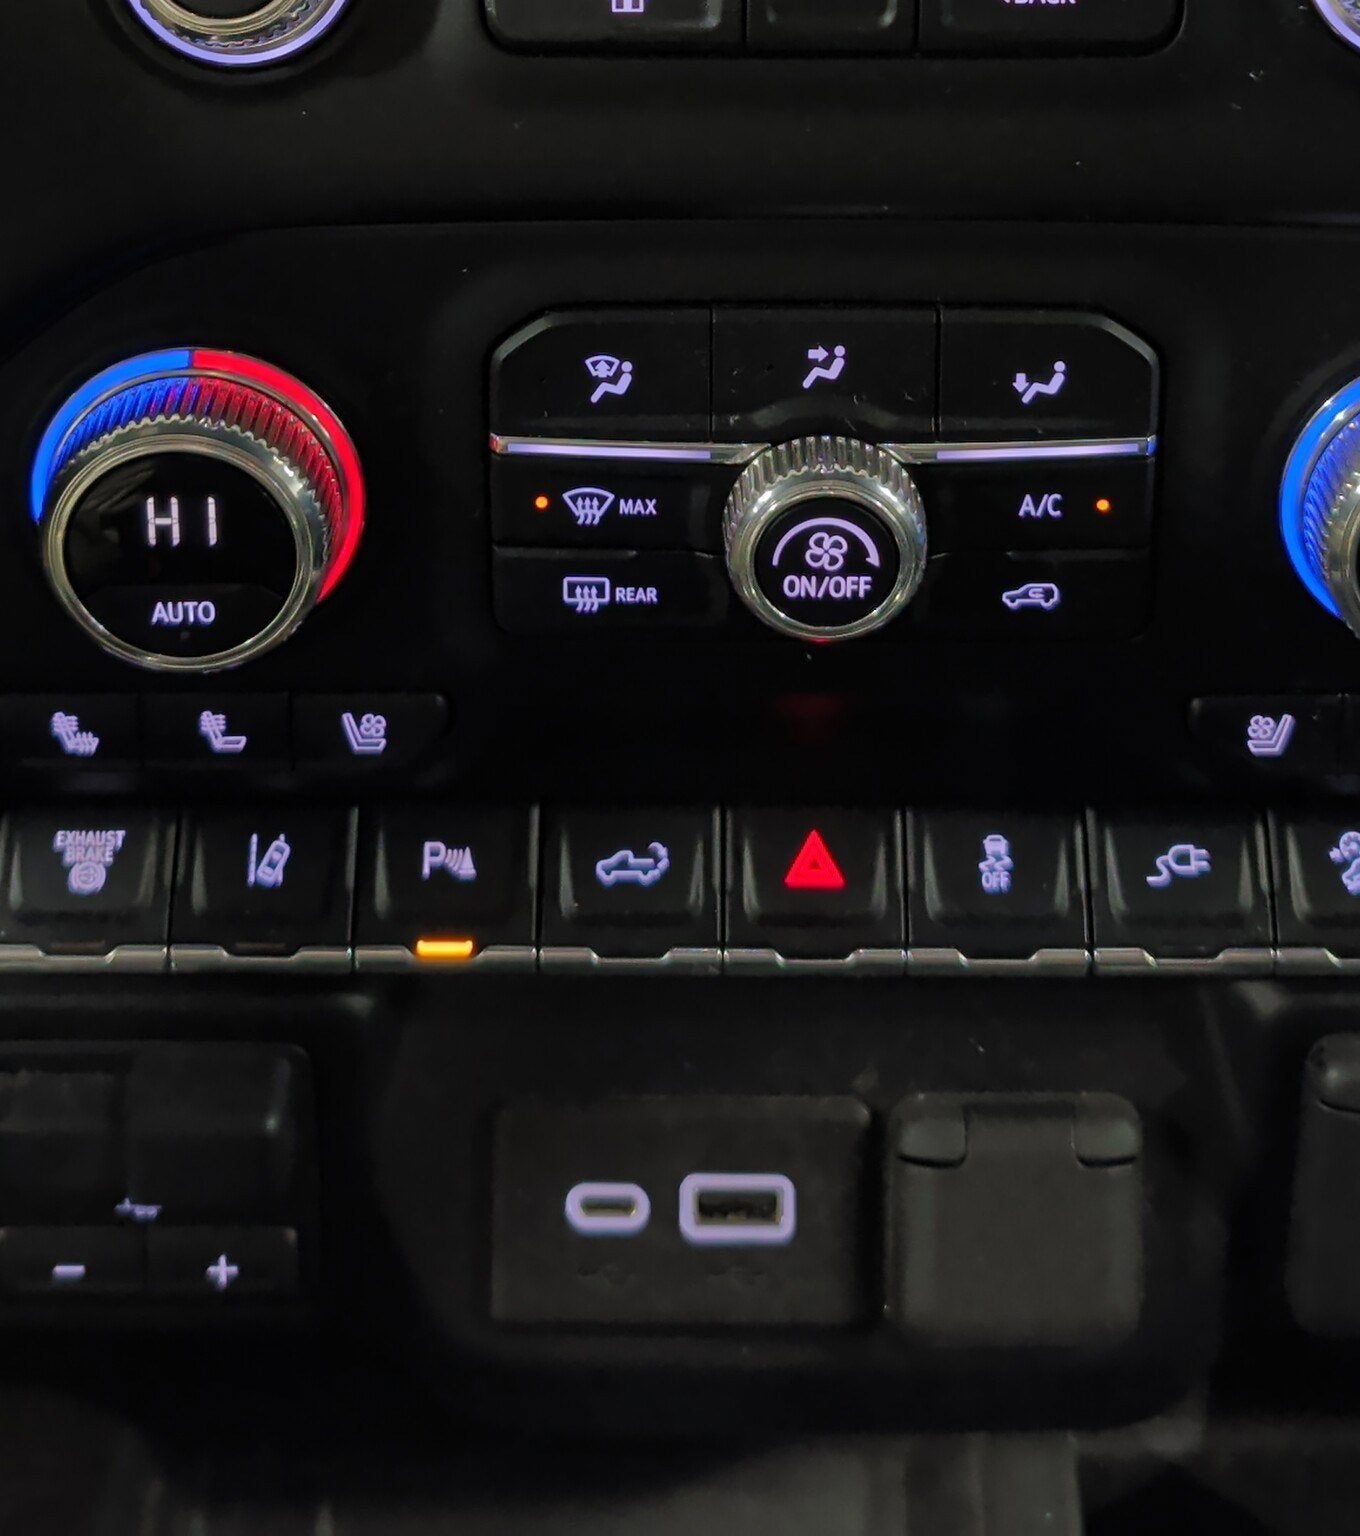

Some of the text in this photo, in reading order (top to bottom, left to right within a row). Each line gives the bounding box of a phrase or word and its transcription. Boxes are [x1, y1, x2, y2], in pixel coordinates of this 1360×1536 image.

[619, 499, 656, 514] MAX
[1019, 494, 1062, 517] A/C
[616, 587, 657, 602] REAR
[783, 575, 872, 598] ON/OFF
[152, 601, 215, 624] AUTO
[54, 830, 126, 848] EXHAUST
[63, 846, 114, 866] BRAKE
[981, 872, 1011, 893] OFF
